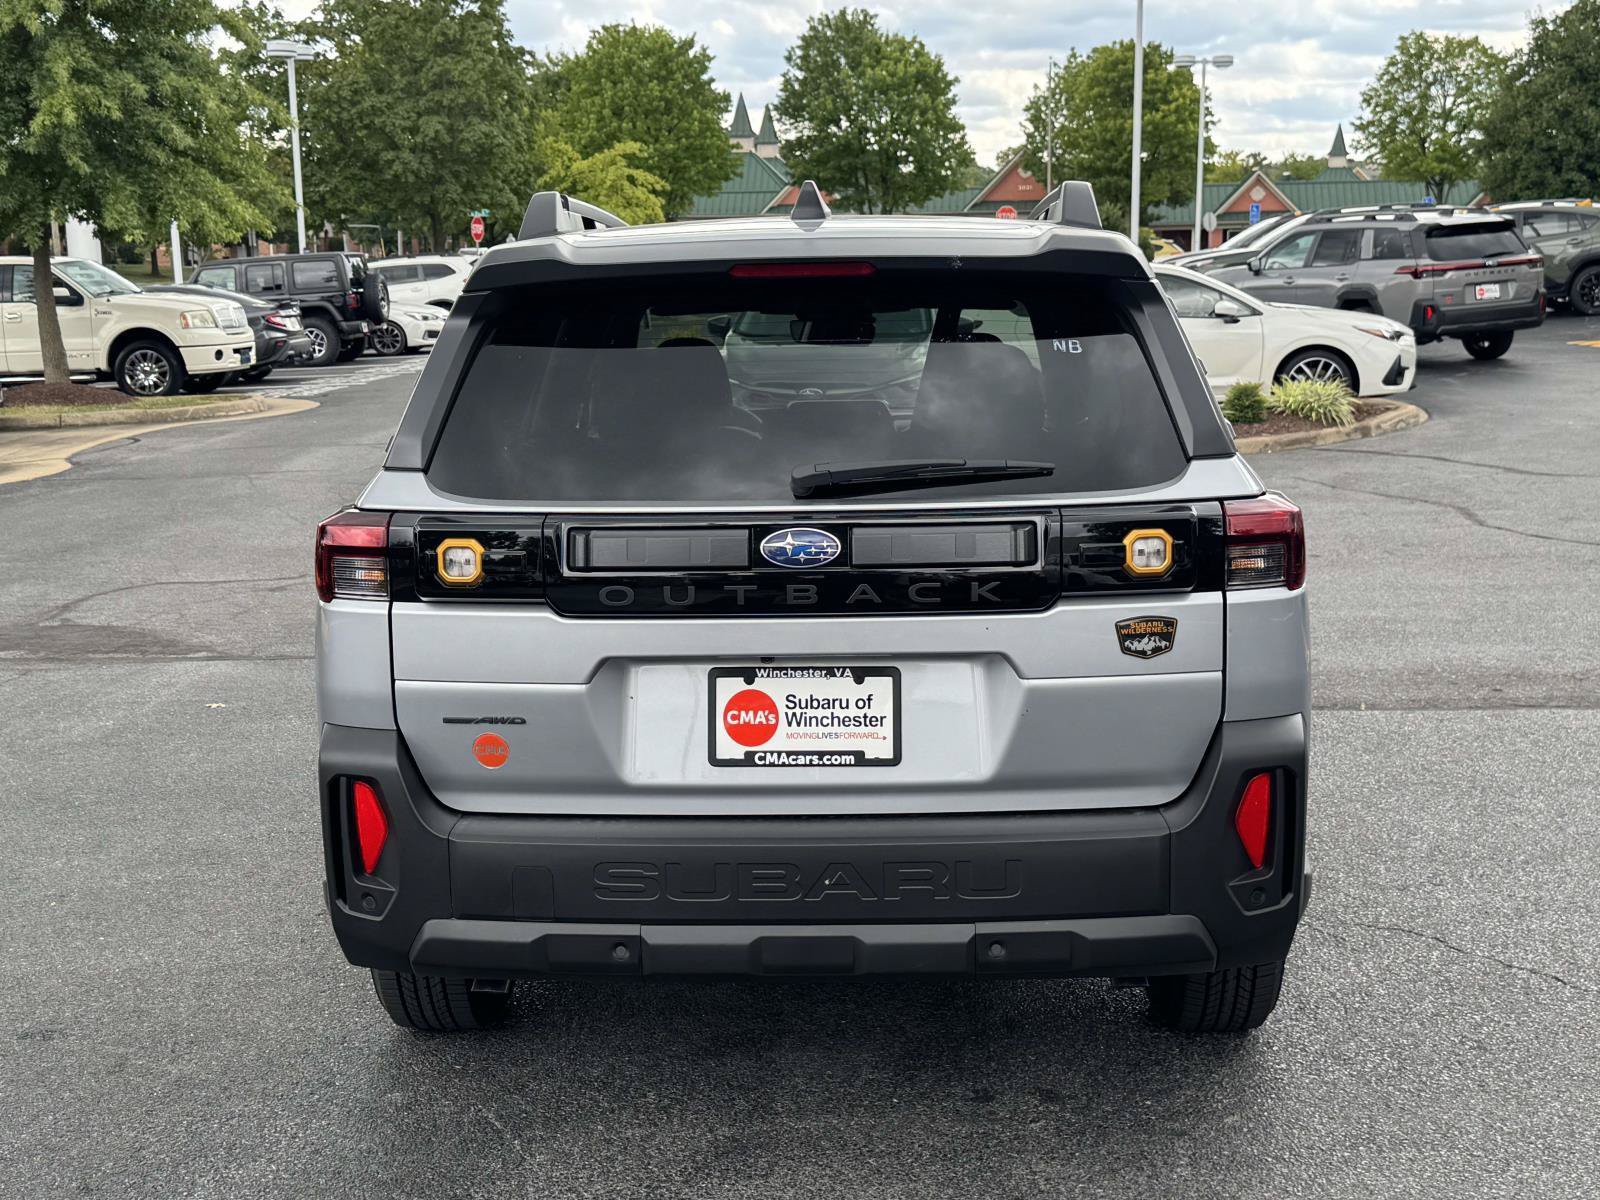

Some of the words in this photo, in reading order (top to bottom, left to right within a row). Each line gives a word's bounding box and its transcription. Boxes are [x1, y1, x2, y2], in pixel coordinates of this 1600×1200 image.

[471, 223, 484, 234] STOP
[1052, 339, 1083, 353] NB
[599, 581, 1002, 607] OUTBACK
[1121, 626, 1174, 635] WILDERNESS
[1130, 621, 1164, 629] SUBARU
[755, 668, 831, 680] Winchester,
[834, 668, 853, 678] VA
[785, 694, 850, 710] Subaru
[855, 694, 874, 710] of
[473, 717, 527, 725] AWD
[726, 710, 777, 725] CMA's
[785, 711, 887, 728] Winchester
[754, 752, 855, 765] CMAcars.com
[593, 858, 1023, 902] SUBARU
